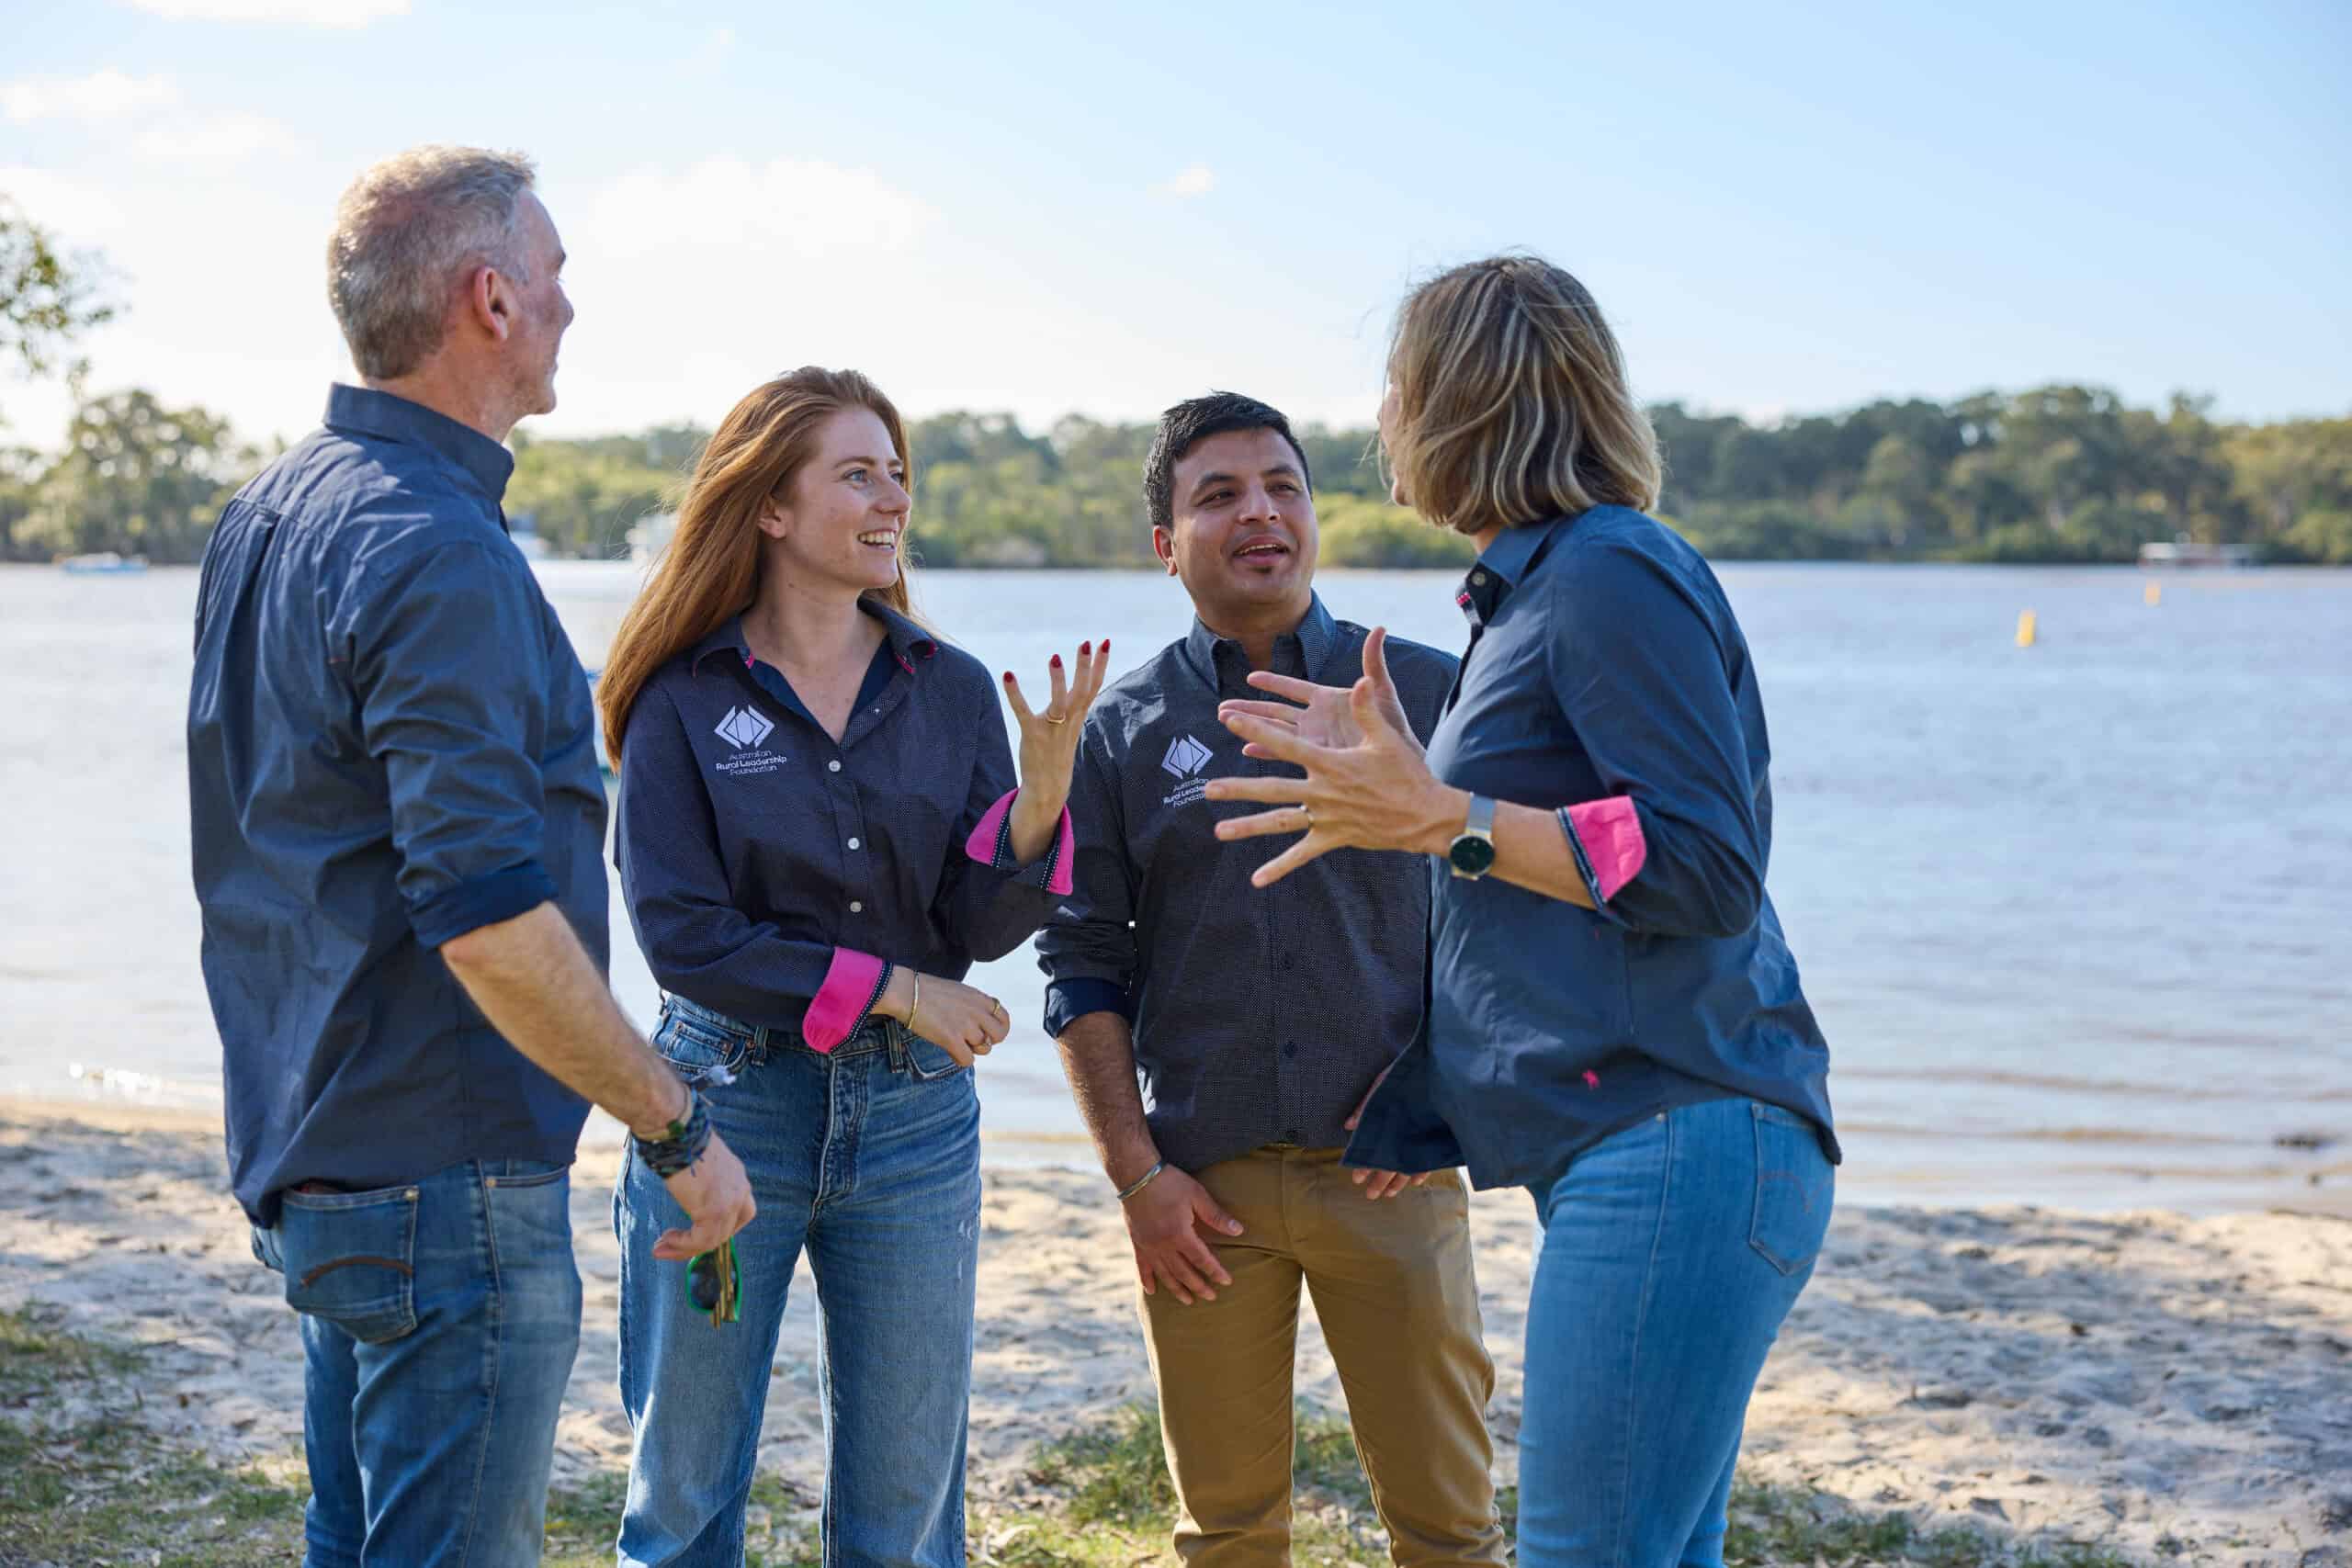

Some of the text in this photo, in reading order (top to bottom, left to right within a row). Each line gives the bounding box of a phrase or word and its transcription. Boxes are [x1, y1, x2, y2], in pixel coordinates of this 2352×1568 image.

[729, 750, 772, 761] Australian
[716, 755, 787, 771] Rural Leadership
[729, 765, 777, 775] Foundation
[1181, 785, 1205, 796] Leade
